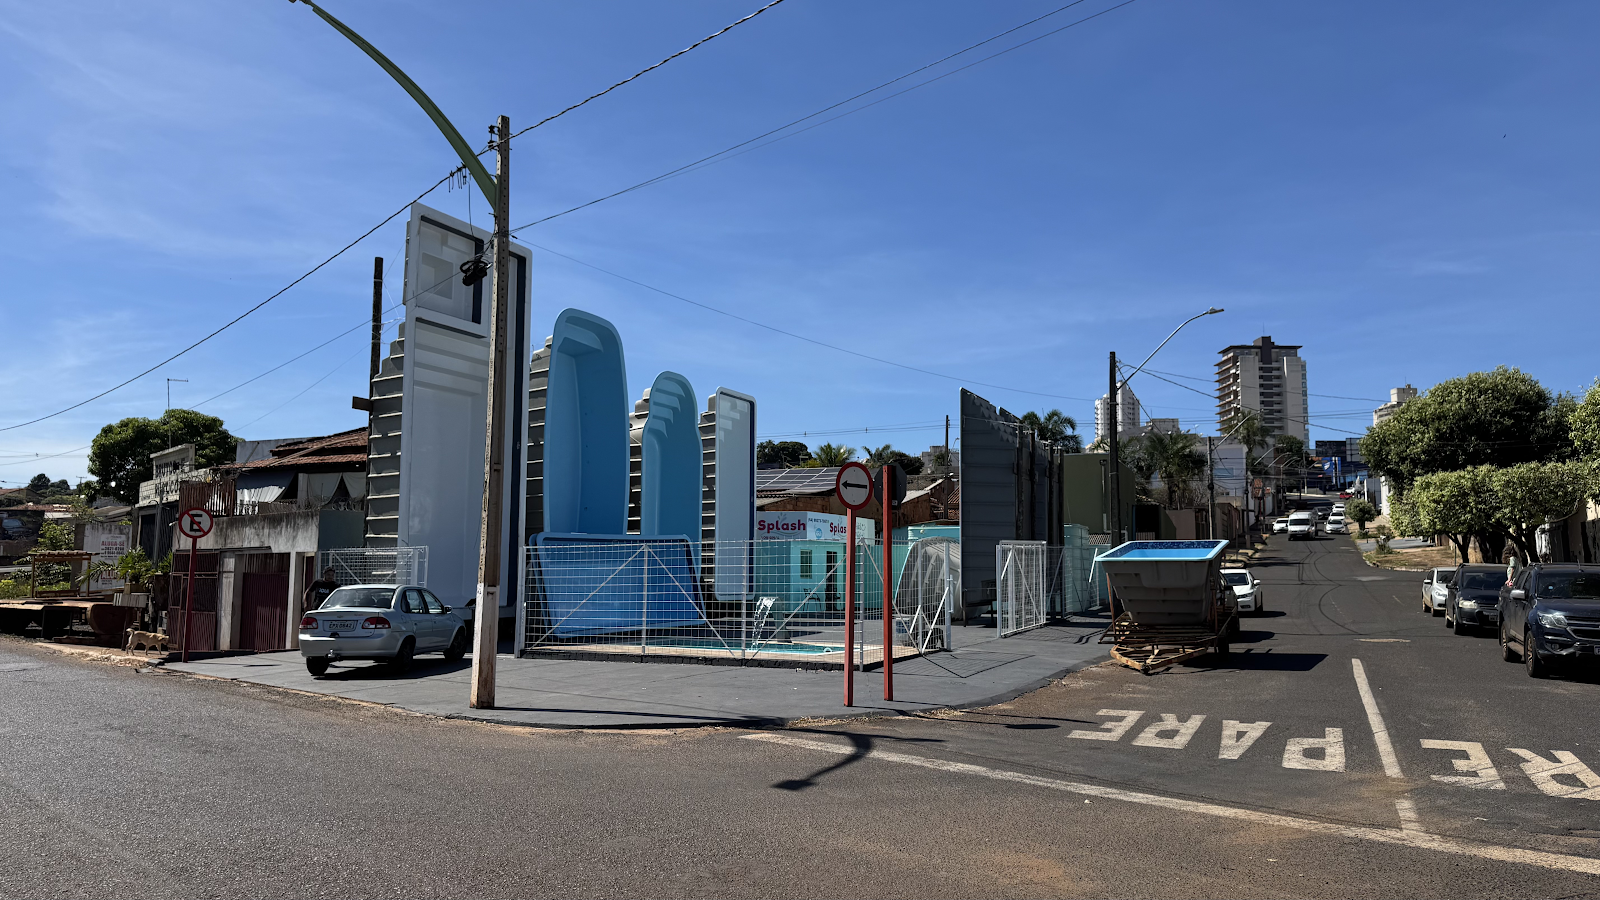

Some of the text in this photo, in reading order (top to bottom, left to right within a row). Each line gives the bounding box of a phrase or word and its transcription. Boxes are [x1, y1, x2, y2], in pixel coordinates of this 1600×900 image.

[189, 513, 203, 532] E
[758, 519, 806, 533] Splash
[829, 522, 847, 536] Splas
[1065, 709, 1346, 772] PARE
[1420, 739, 1600, 800] RE
